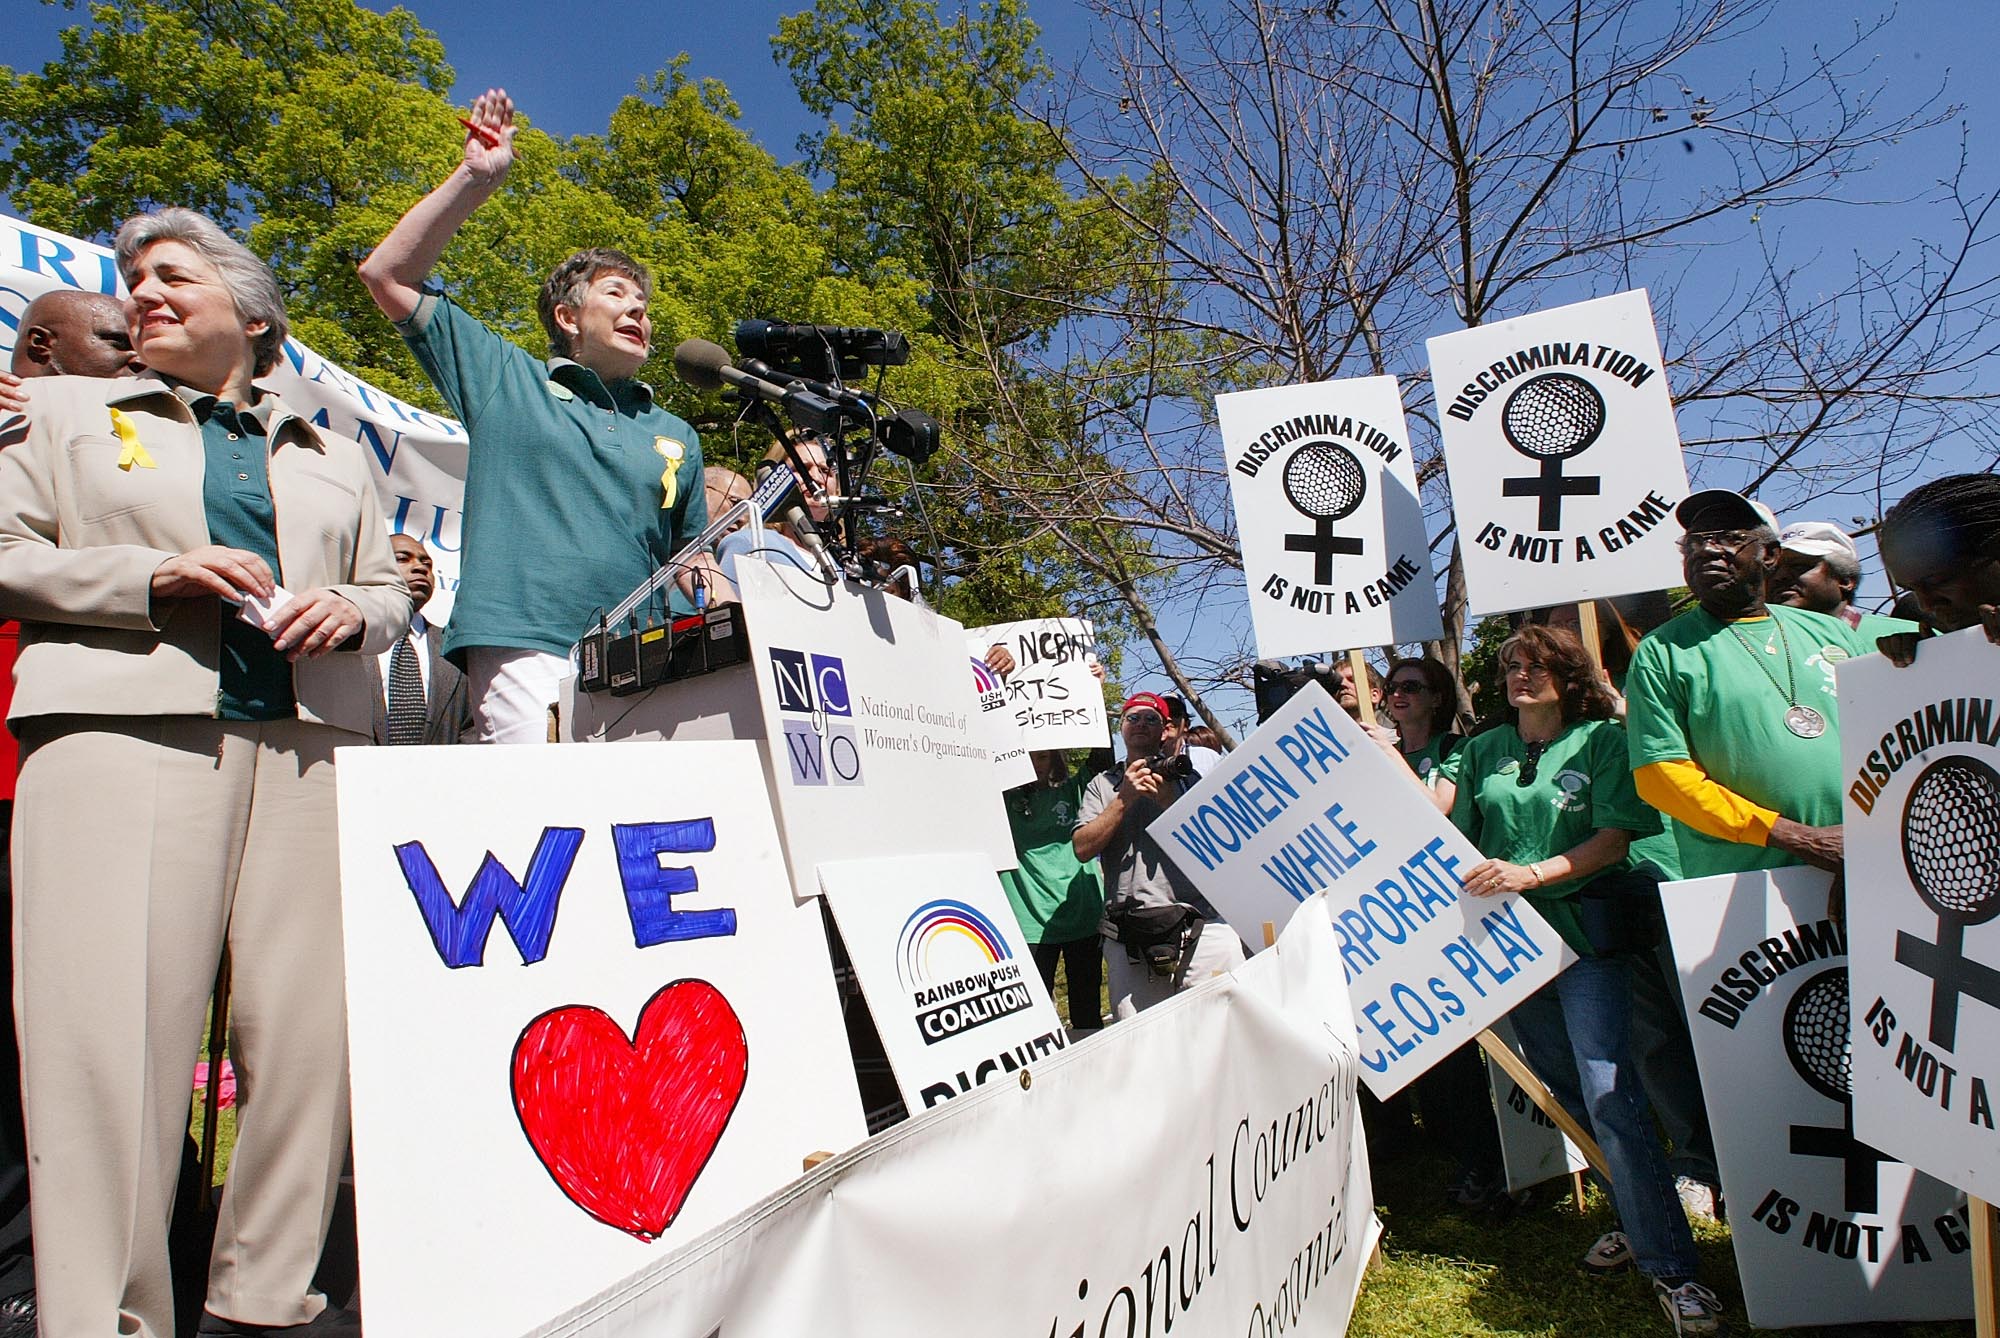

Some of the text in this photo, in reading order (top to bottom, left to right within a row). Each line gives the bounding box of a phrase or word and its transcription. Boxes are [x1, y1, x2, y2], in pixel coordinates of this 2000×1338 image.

[1446, 342, 1655, 422] DISCRIMINATION
[1235, 415, 1402, 479] DISCRIMINATION
[757, 468, 791, 506] ETWORKS
[1475, 489, 1676, 564] IS NOT A GAME
[1261, 553, 1421, 615] IS NOT A GAME
[861, 696, 914, 722] National
[917, 705, 954, 730] Council
[958, 714, 967, 735] of
[980, 691, 1003, 704] USH
[864, 728, 987, 760] Women's Organizations
[994, 747, 1026, 763] ATION
[1171, 707, 1350, 871] WOMEN PAY
[1261, 802, 1377, 903] WHILE
[392, 817, 737, 969] WE
[1332, 836, 1469, 985] RPORATE
[1441, 901, 1543, 997] PLAY
[914, 964, 1020, 1008] RAINBOW PUSH
[923, 986, 1031, 1038] COALITION
[1864, 996, 1995, 1130] IS NOT A
[1752, 1188, 1800, 1235] IS
[1802, 1211, 1884, 1263] NOT
[1901, 1224, 1932, 1264] A
